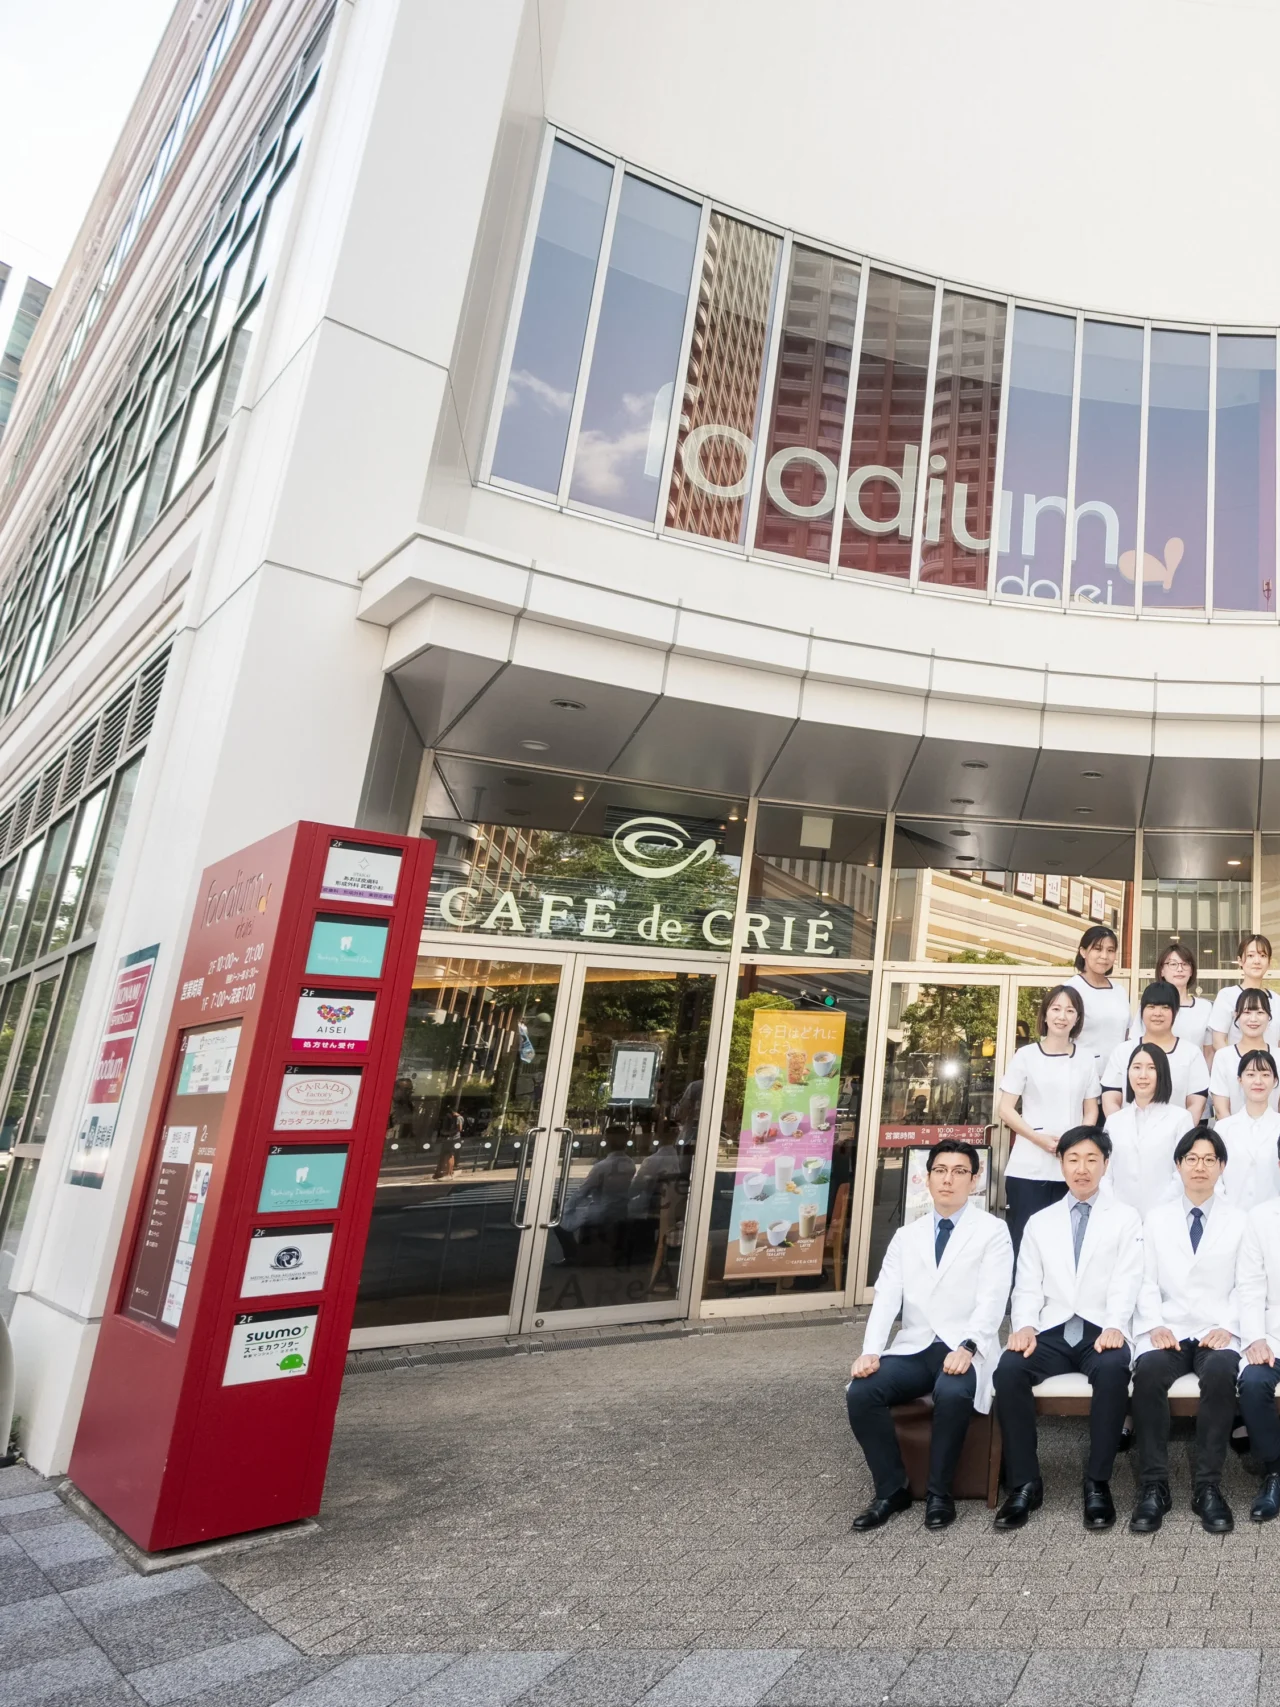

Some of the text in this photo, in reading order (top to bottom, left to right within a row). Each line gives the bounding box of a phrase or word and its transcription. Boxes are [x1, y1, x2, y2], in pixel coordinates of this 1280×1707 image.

[332, 840, 342, 848] 2F
[637, 904, 682, 942] de
[702, 910, 835, 955] CRIÉ
[244, 943, 264, 964] 21:00
[302, 989, 315, 997] 2F
[317, 1026, 347, 1034] AISEI
[758, 1023, 838, 1039] 今日はどれに
[303, 1041, 356, 1050] 処方せん受付
[286, 1066, 299, 1074] 2F
[279, 1117, 348, 1126] カラダ ファクトリー
[885, 1131, 916, 1140] 営業時間
[271, 1146, 282, 1154] 2F
[254, 1228, 266, 1237] 2F
[239, 1315, 253, 1324] 2F
[244, 1341, 299, 1354] スーモカウンター
